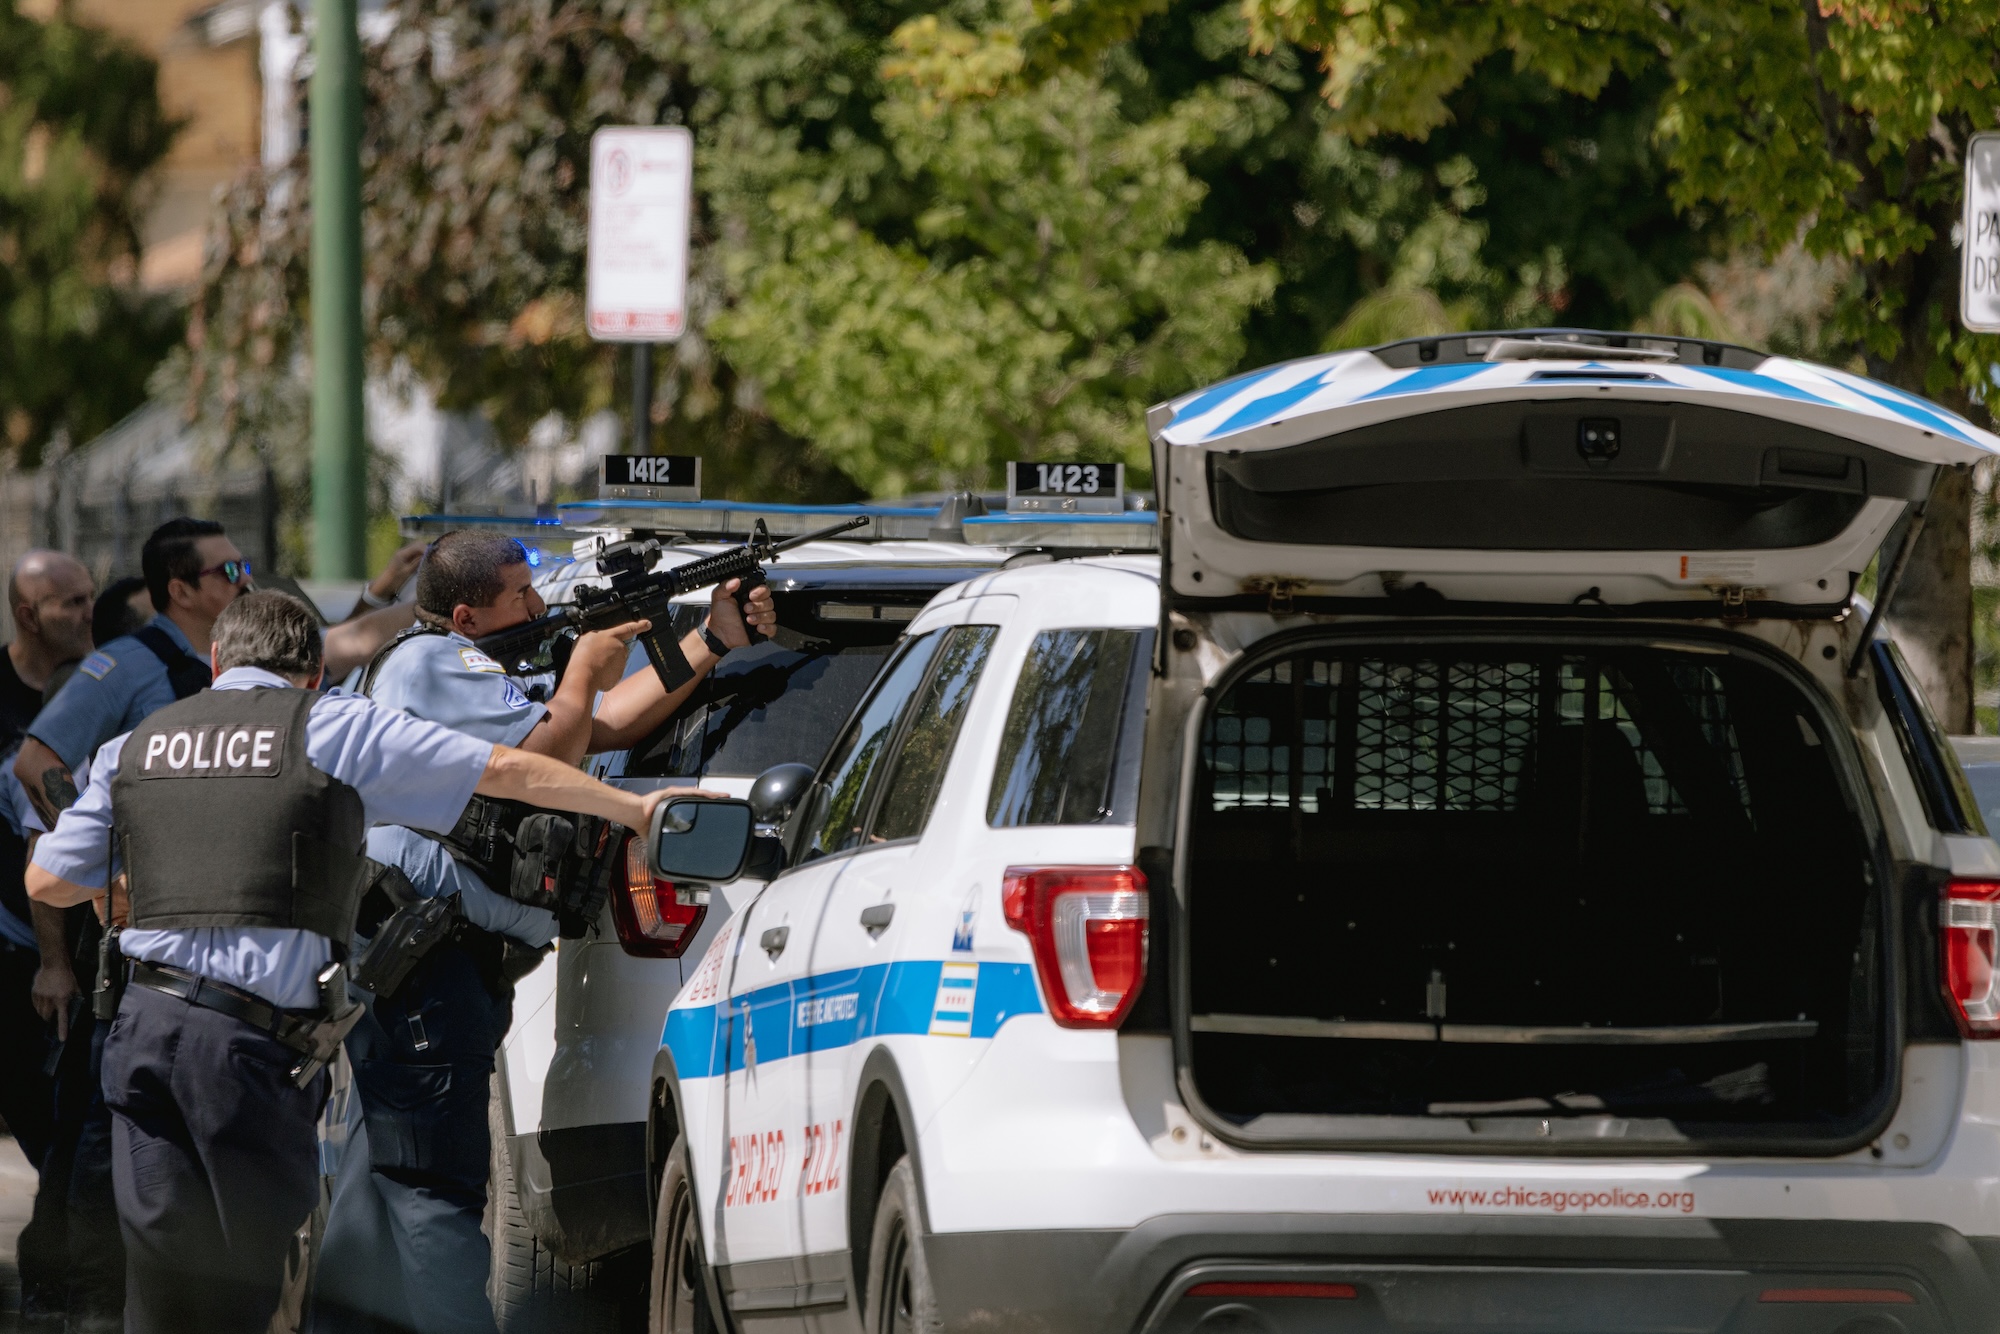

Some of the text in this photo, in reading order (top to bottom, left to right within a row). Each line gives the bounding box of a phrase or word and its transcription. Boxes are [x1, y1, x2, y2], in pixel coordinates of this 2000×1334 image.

[626, 456, 670, 483] 1412
[1036, 464, 1100, 494] 1423
[144, 730, 275, 770] POLICE
[726, 1119, 842, 1207] CHICAGO POLIC
[1427, 1185, 1695, 1213] www.chicagopolice.org
